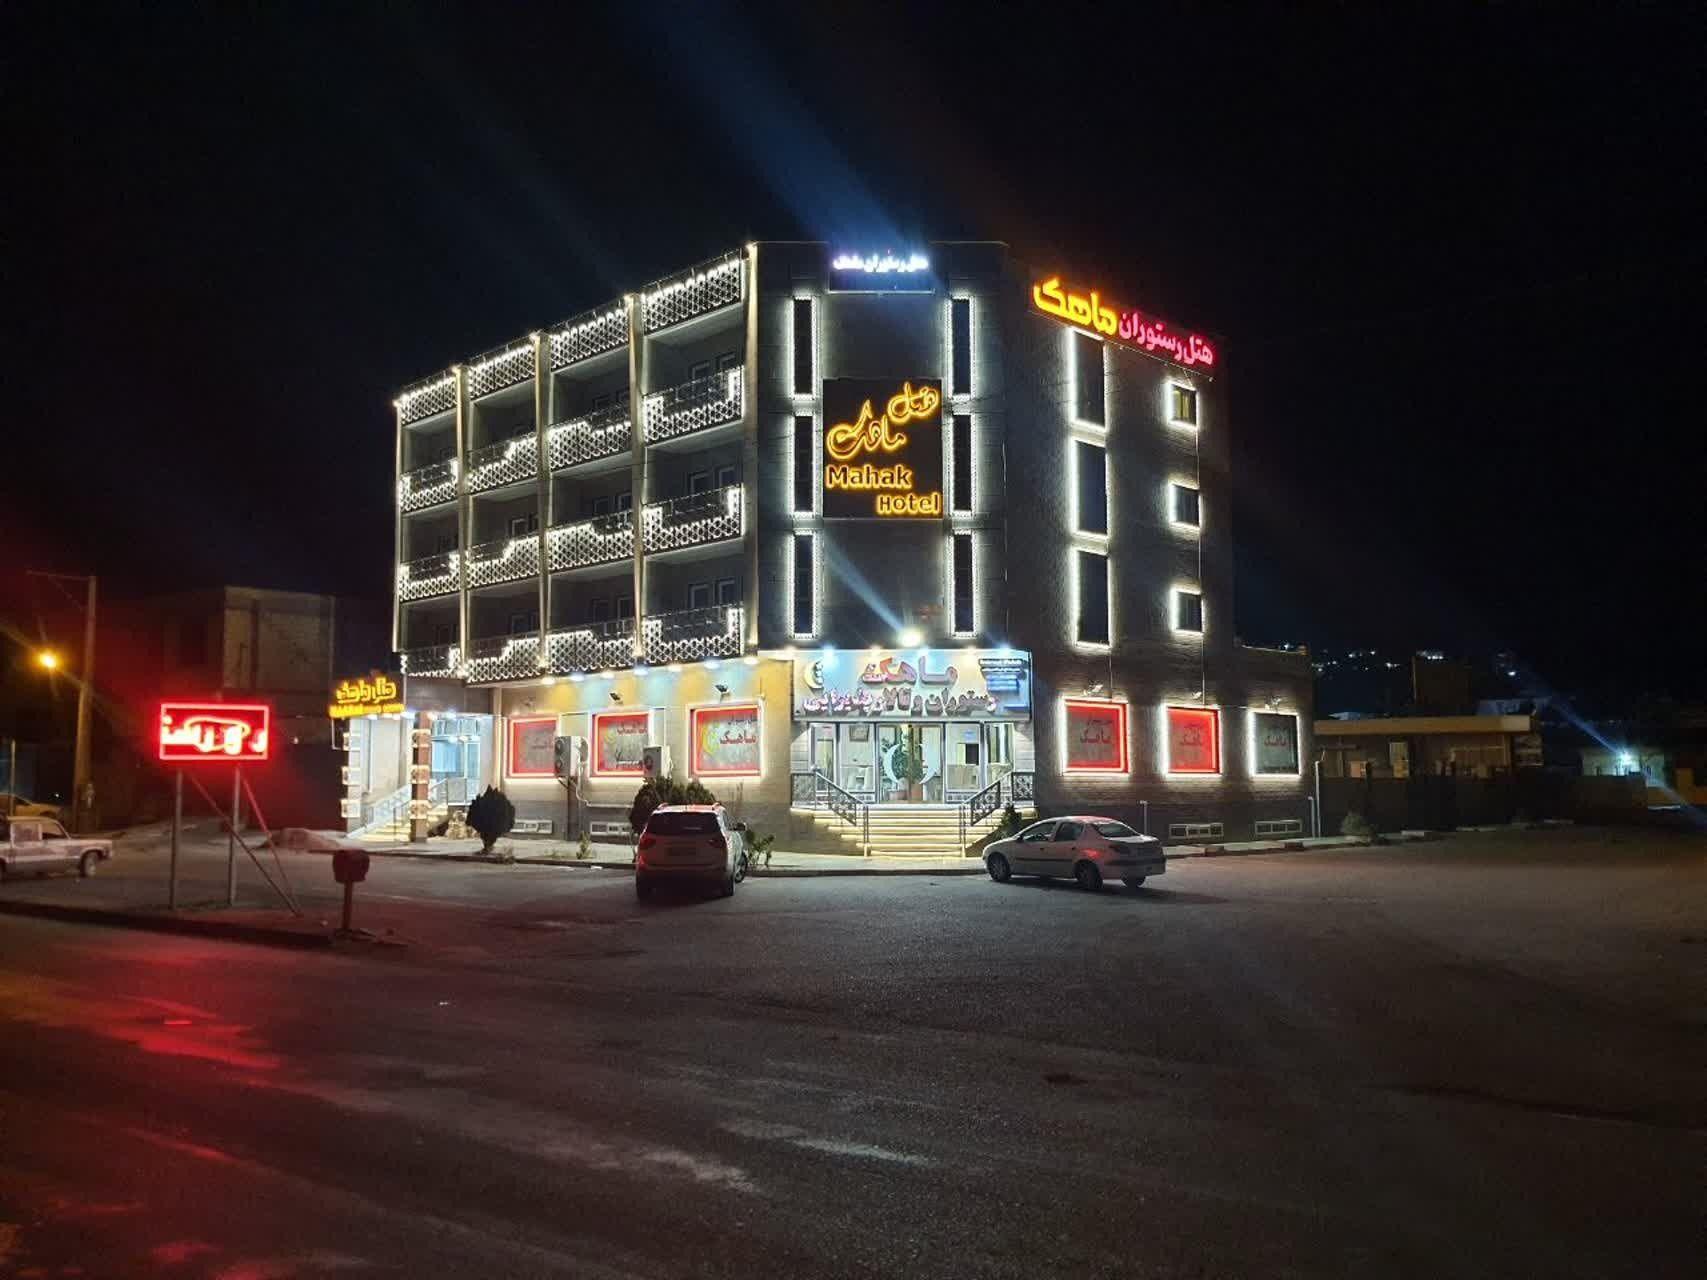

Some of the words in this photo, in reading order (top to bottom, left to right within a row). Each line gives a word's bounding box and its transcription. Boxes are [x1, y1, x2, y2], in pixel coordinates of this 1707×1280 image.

[1033, 277, 1118, 336] ماهک
[1117, 310, 1183, 362] رستوران
[1182, 334, 1214, 366] هتل
[887, 381, 940, 423] هتل
[826, 399, 907, 460] ماهک
[826, 463, 913, 489] Mahak
[876, 491, 941, 515] Hotel
[872, 687, 912, 712] تالار
[912, 695, 923, 712] و
[924, 687, 998, 713] رستوران
